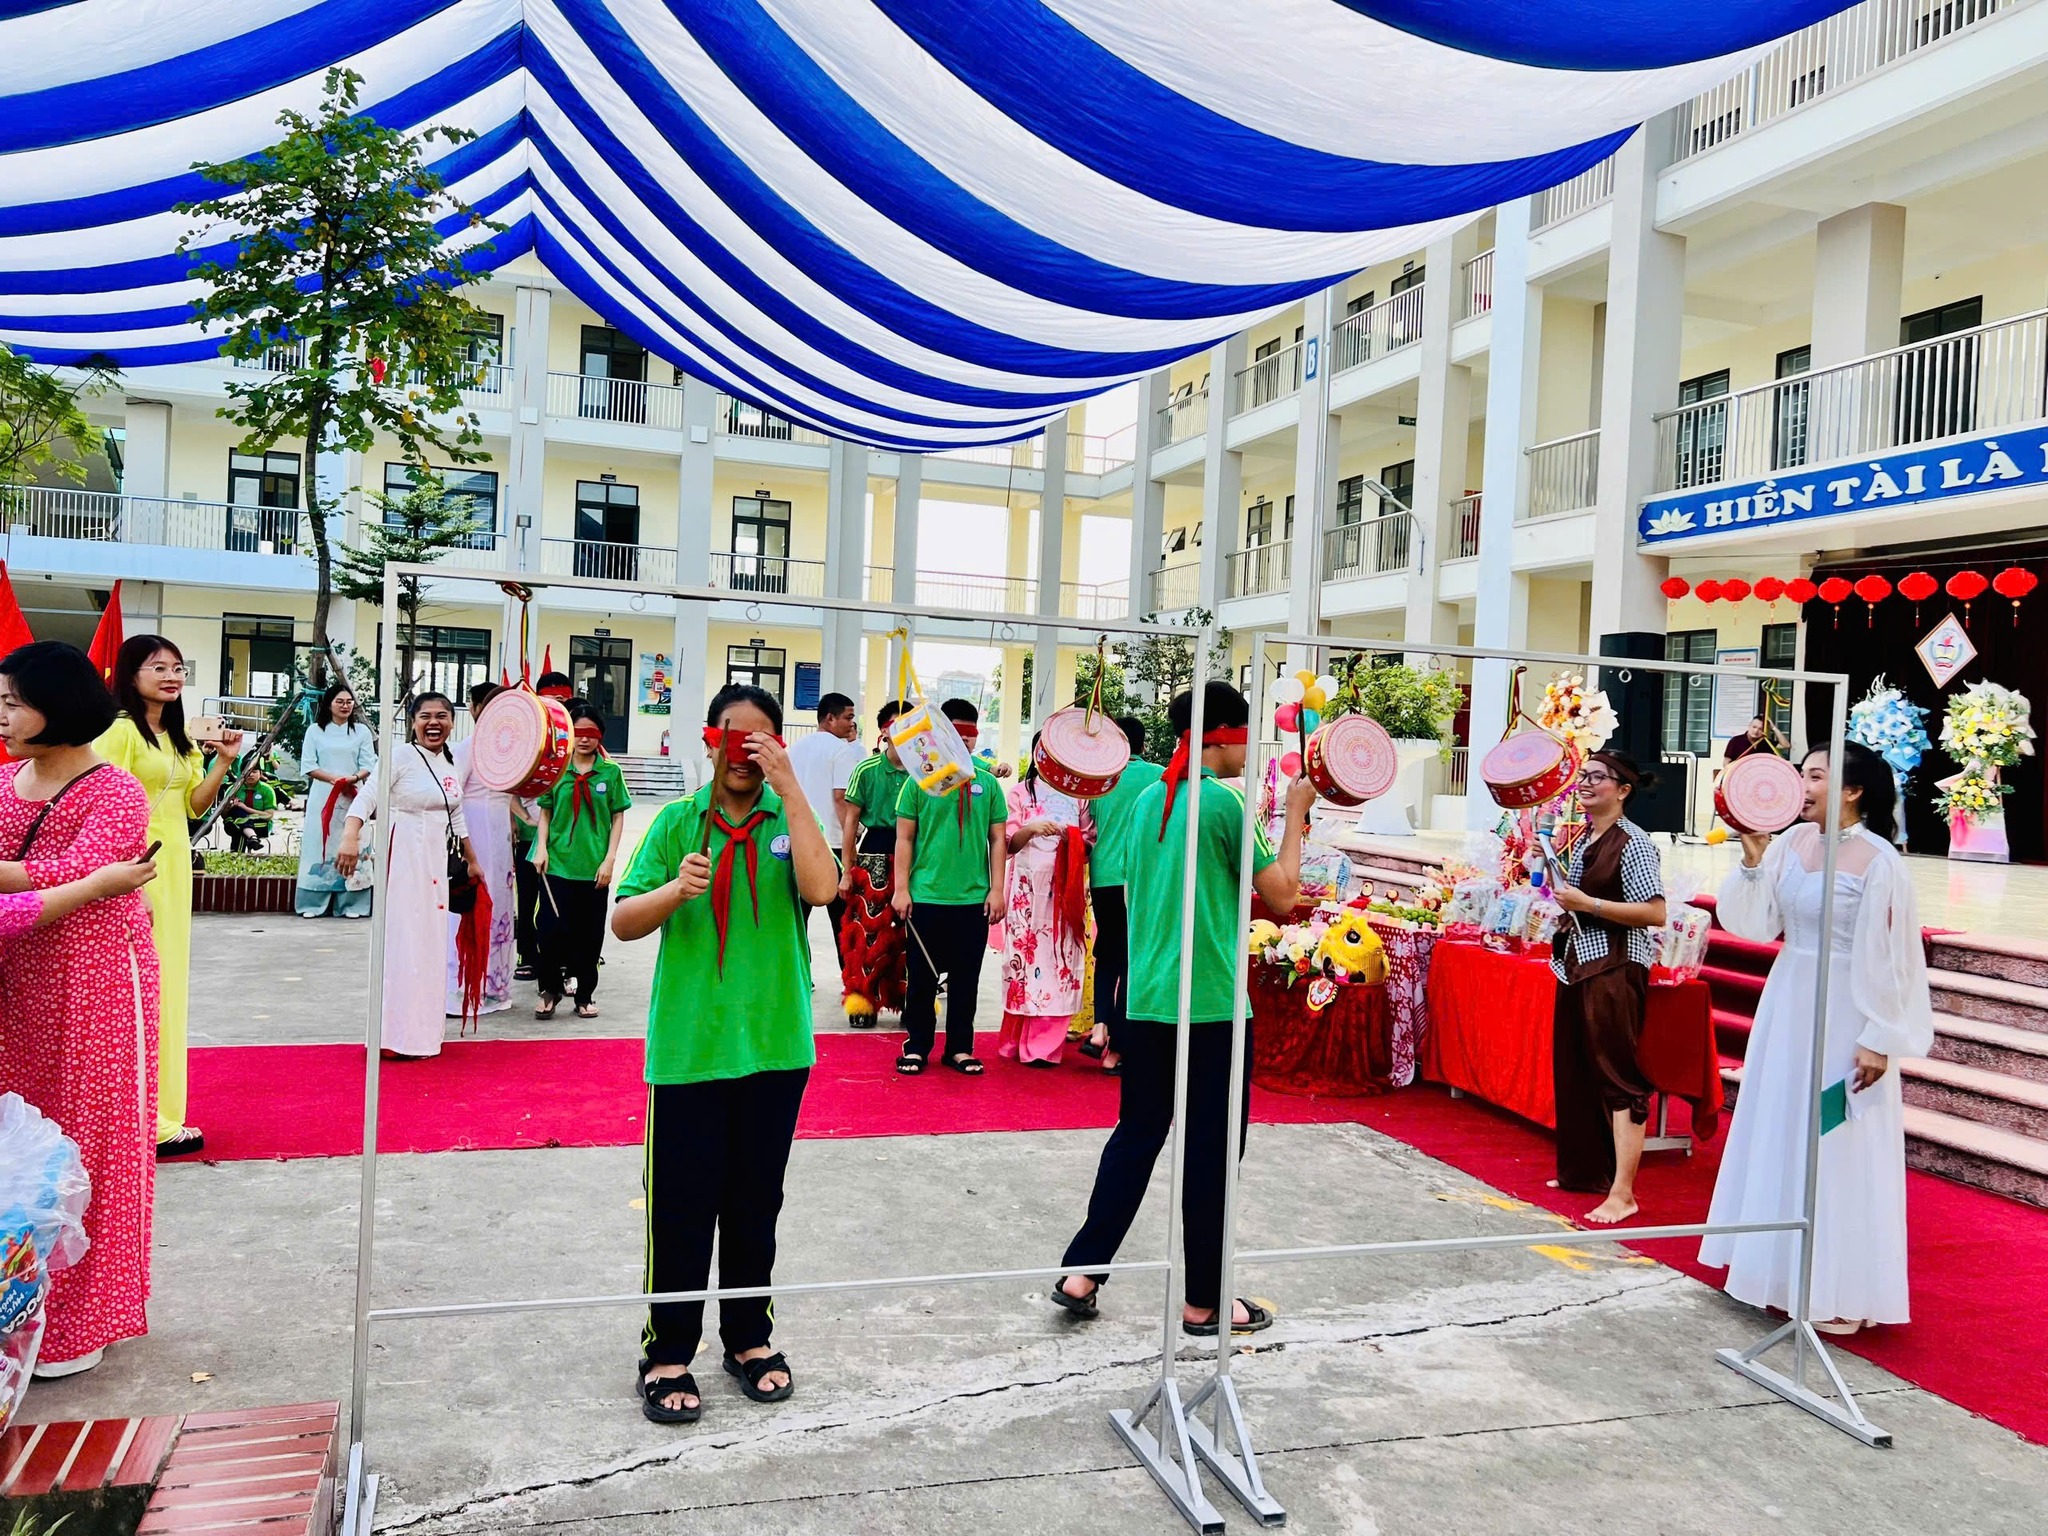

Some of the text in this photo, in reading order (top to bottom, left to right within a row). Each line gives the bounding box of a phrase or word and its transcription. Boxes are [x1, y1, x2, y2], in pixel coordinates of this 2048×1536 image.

[1306, 342, 1316, 376] B
[1703, 480, 1816, 528] HIỀN
[1826, 463, 1927, 507] TÀI
[1938, 441, 2025, 489] LÀ
[1, 1283, 44, 1333] POCA
